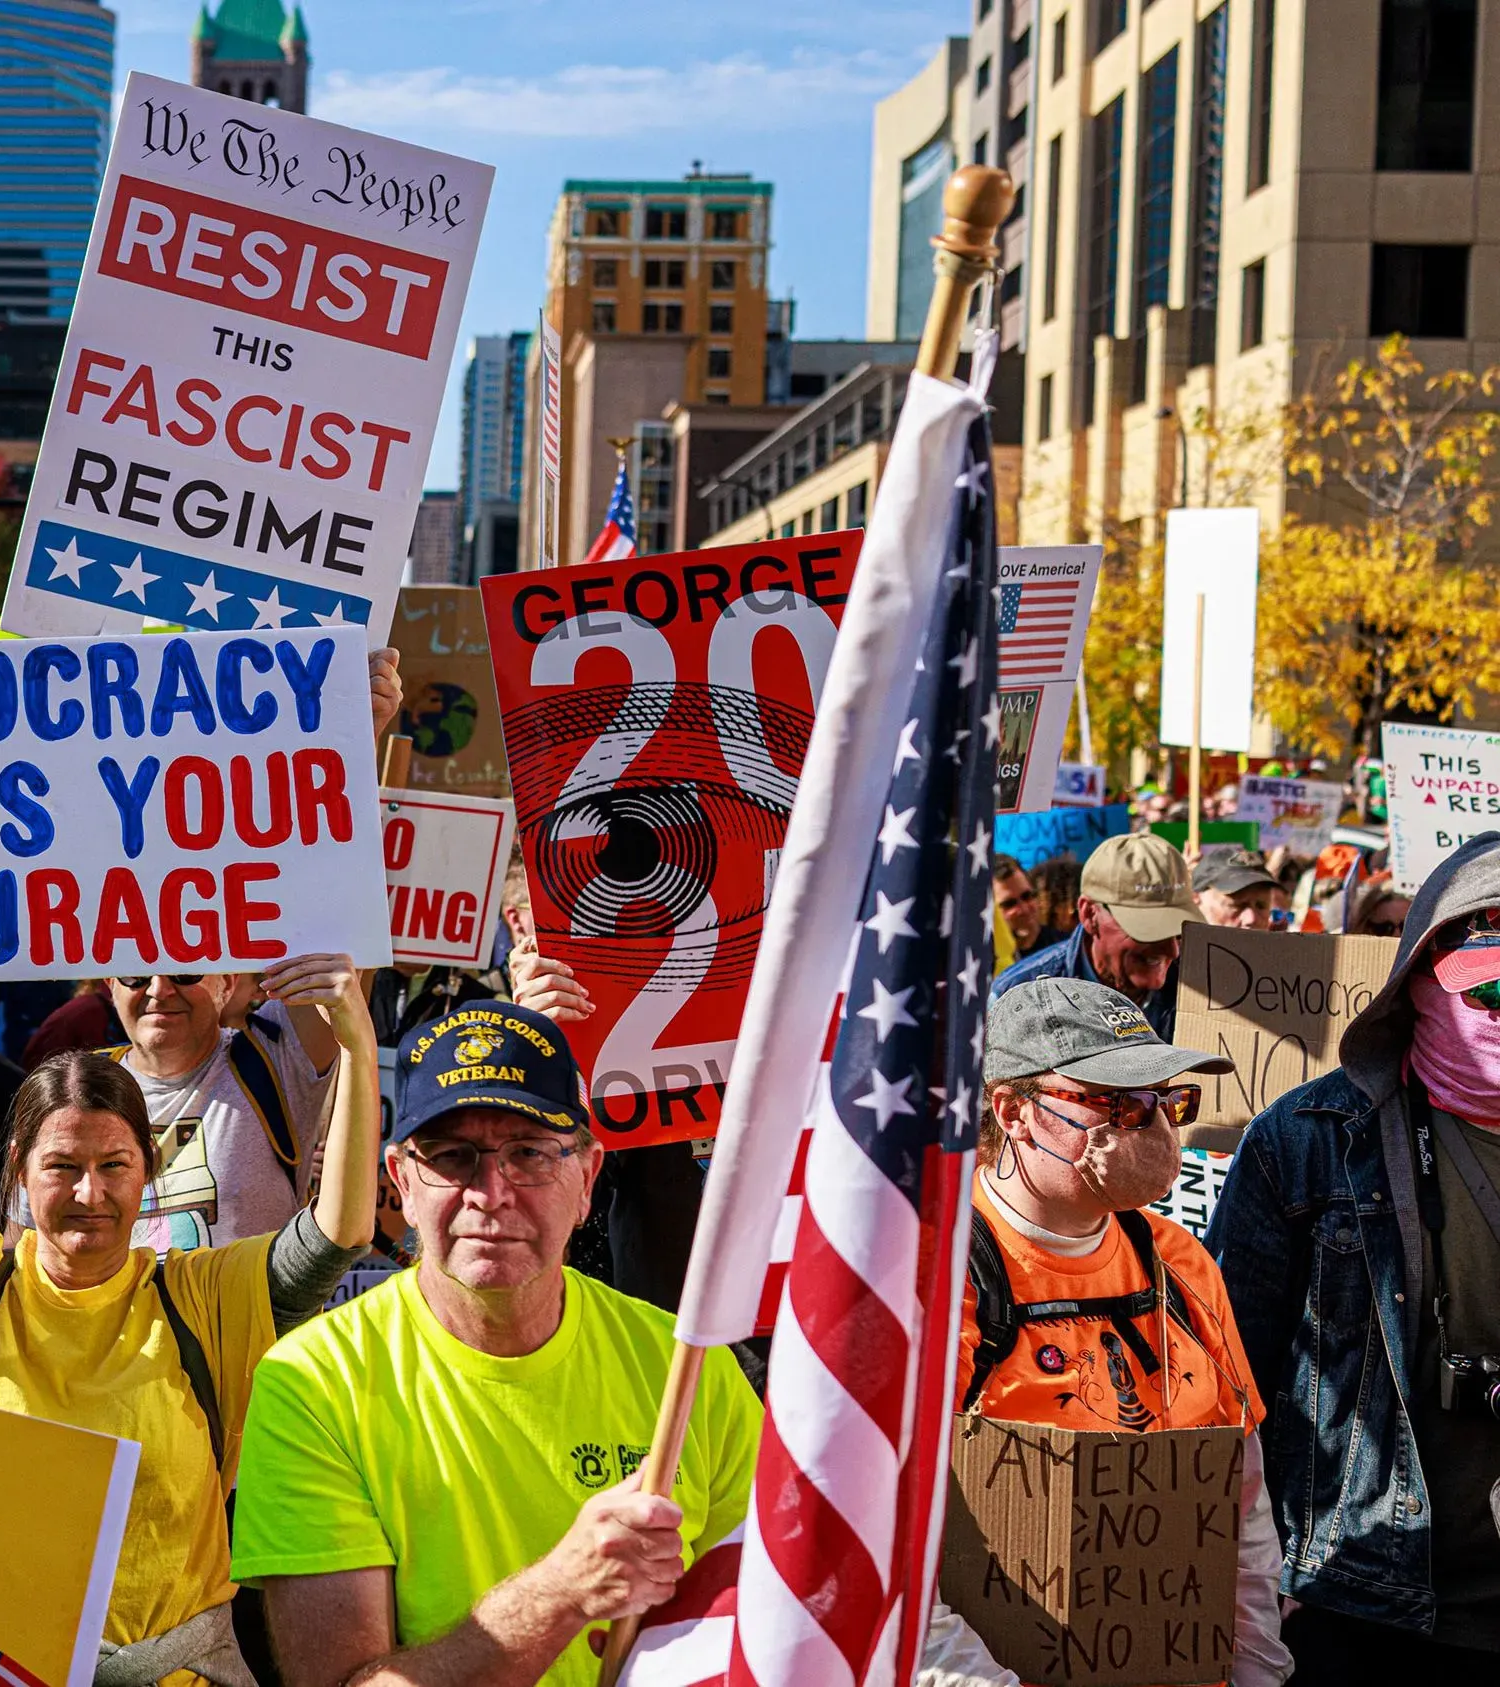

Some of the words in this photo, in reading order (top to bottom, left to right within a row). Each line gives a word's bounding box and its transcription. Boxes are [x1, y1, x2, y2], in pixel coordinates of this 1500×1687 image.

[139, 97, 210, 170] We
[221, 119, 304, 189] The
[312, 147, 466, 233] People
[117, 197, 431, 335] RESIST
[212, 326, 294, 372] THIS
[67, 348, 411, 492] FASCIST
[64, 448, 373, 576] REGIME
[512, 547, 849, 644] GEORGE
[996, 564, 1027, 578] OVE
[1029, 561, 1086, 576] America!
[1411, 775, 1500, 796] UNPAID
[1419, 753, 1482, 775] THIS
[99, 748, 353, 859] YOUR
[380, 817, 416, 872] O
[410, 1036, 435, 1064] U.S.
[431, 1010, 503, 1039] MARINE
[504, 1018, 556, 1058] CORPS
[436, 1066, 526, 1089] VETERAN
[1417, 1125, 1433, 1175] PowerShot
[985, 1428, 1244, 1499] AMERICA
[1094, 1503, 1162, 1553] NO
[982, 1551, 1203, 1610] AMERICA
[1061, 1618, 1132, 1680] NO
